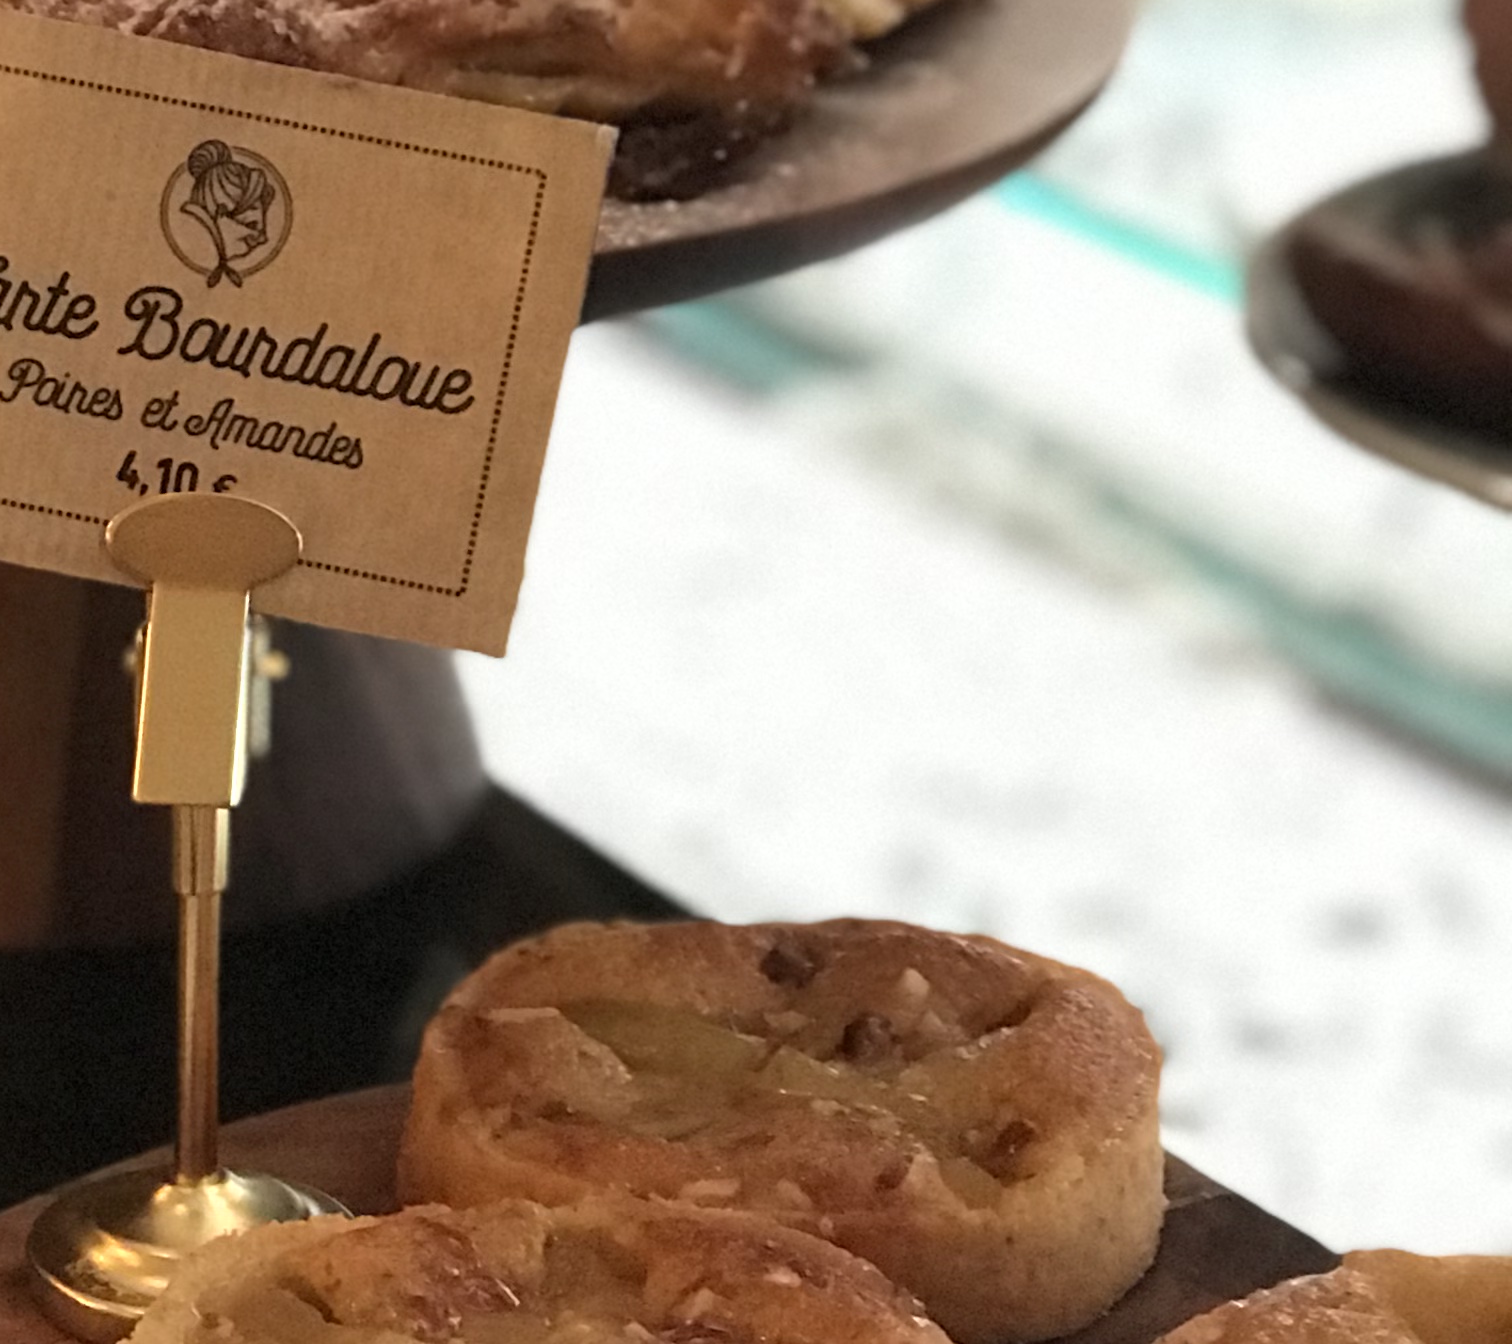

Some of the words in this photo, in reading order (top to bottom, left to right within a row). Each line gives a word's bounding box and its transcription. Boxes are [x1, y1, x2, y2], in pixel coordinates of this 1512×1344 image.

[117, 285, 476, 415] Bourdaloue
[140, 389, 181, 432] et
[183, 397, 364, 470] Amandes
[116, 449, 200, 496] 4,10
